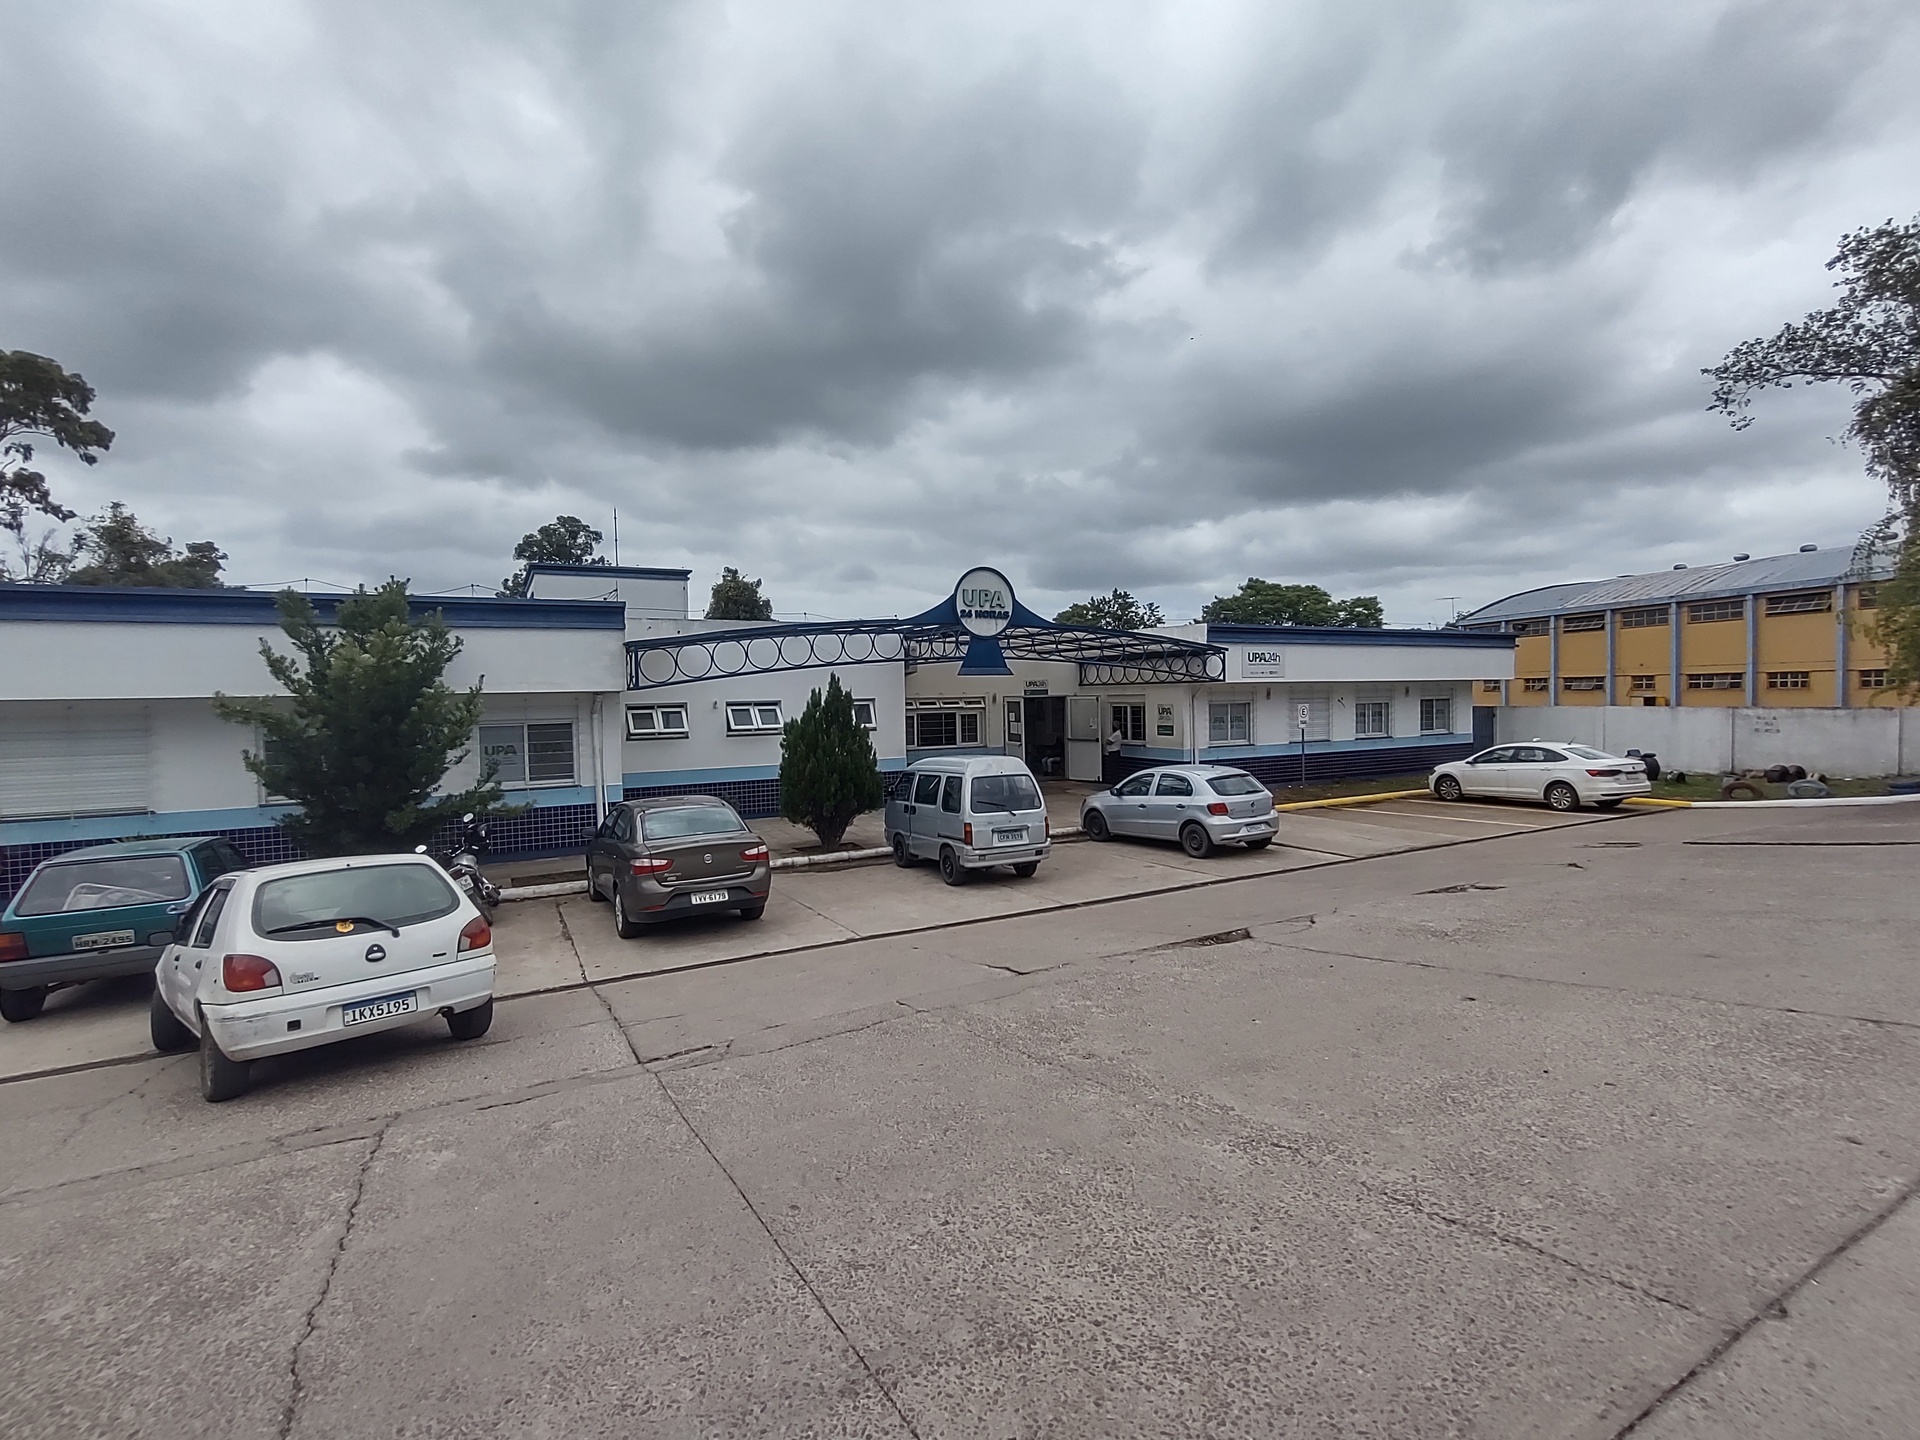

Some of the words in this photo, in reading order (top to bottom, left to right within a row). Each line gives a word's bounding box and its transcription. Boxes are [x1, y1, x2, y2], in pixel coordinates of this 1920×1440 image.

[962, 588, 1006, 609] UPA
[959, 609, 973, 619] 24
[974, 609, 1010, 620] HORAS
[1158, 707, 1172, 716] UPA
[484, 744, 518, 756] UPA
[351, 998, 410, 1022] IKX5I95
